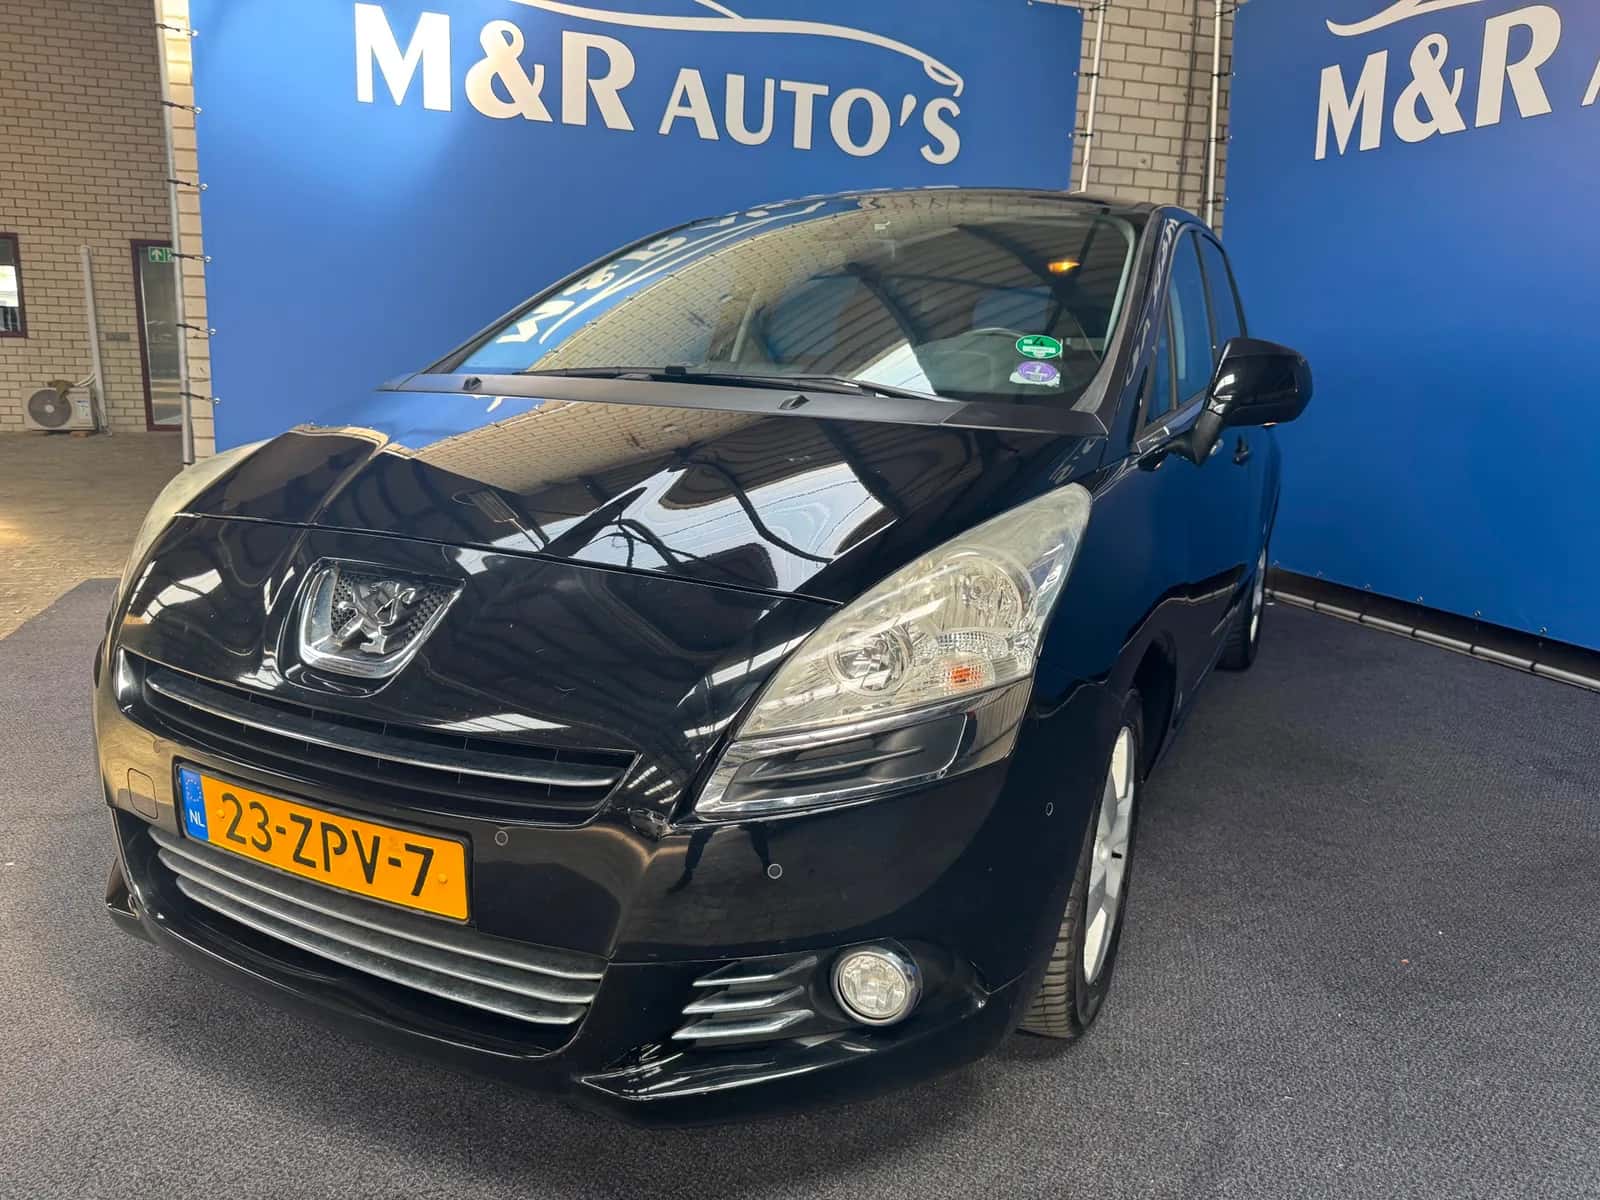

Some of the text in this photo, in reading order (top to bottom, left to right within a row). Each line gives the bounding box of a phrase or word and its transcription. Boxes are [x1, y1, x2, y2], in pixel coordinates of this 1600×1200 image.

[353, 2, 961, 165] M&R AUTO'S
[1314, 4, 1562, 161] M&R
[189, 809, 206, 828] NL
[221, 791, 434, 897] 23-ZPV-7
